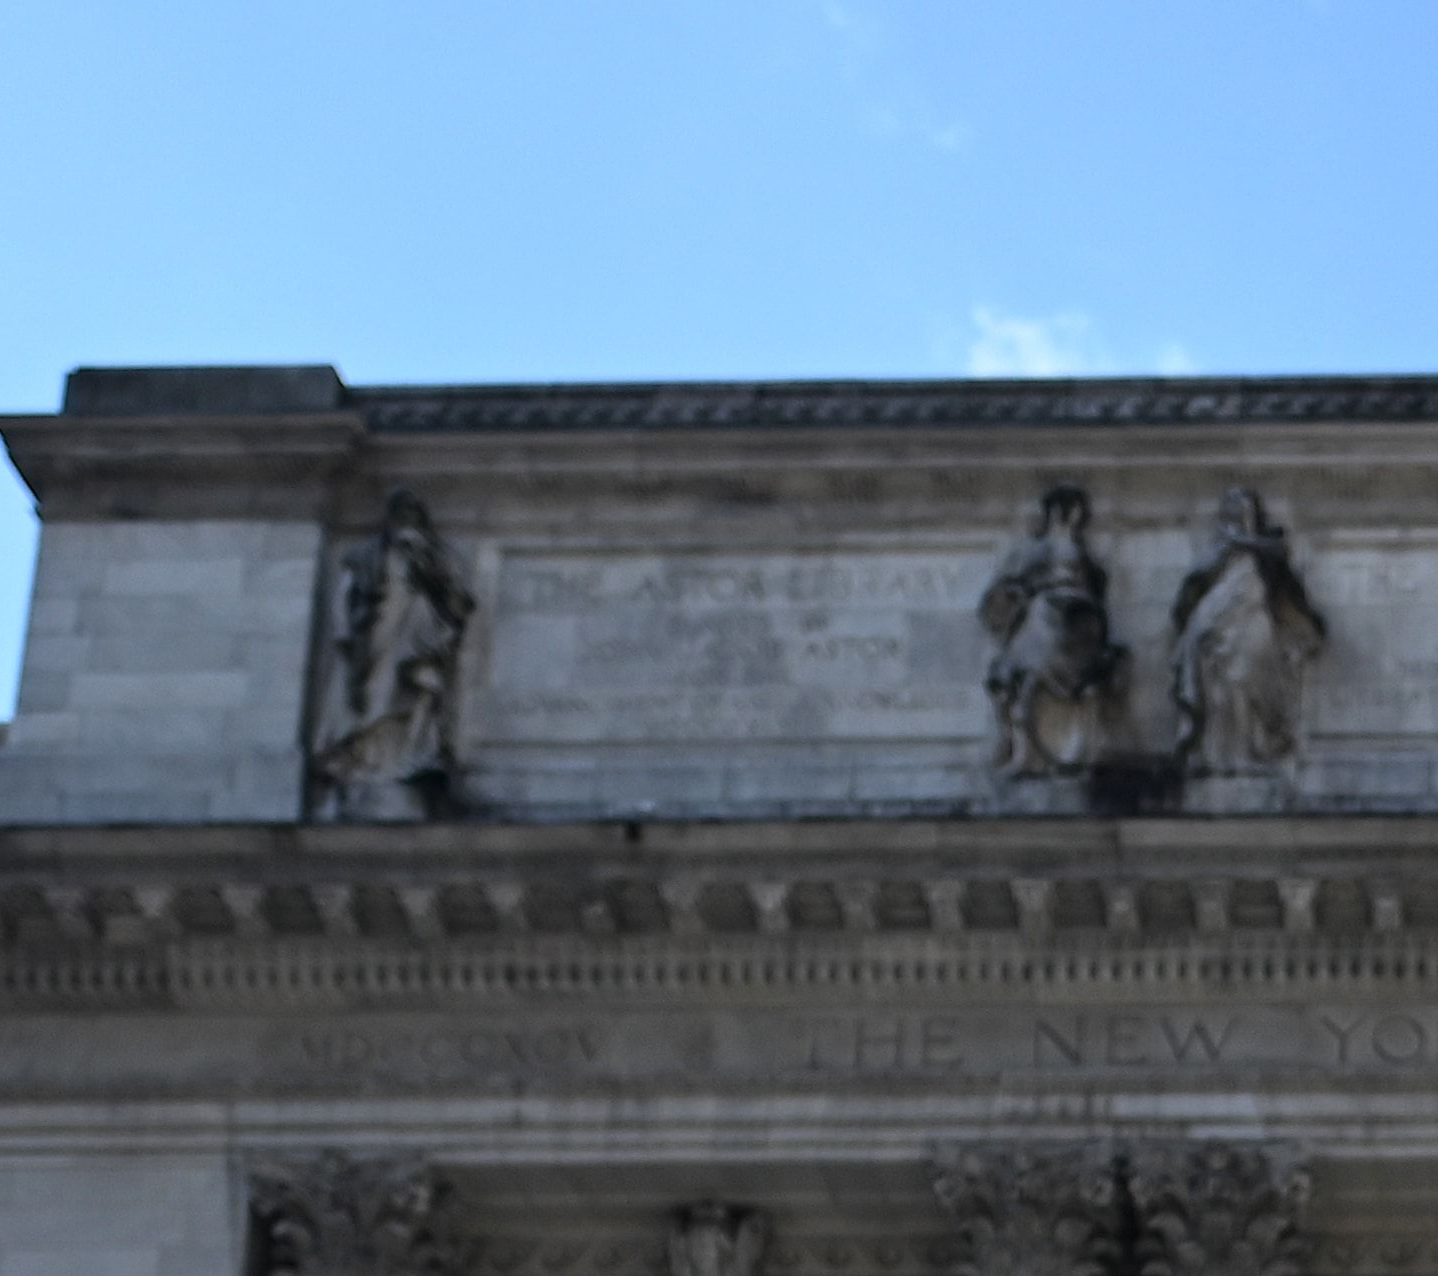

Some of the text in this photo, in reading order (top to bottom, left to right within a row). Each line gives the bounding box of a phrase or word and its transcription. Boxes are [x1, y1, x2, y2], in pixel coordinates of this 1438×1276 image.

[634, 569, 767, 603] ASTOR
[788, 567, 964, 601] LIBRARY
[791, 1015, 964, 1070] THE
[1033, 1013, 1241, 1068] NEW
